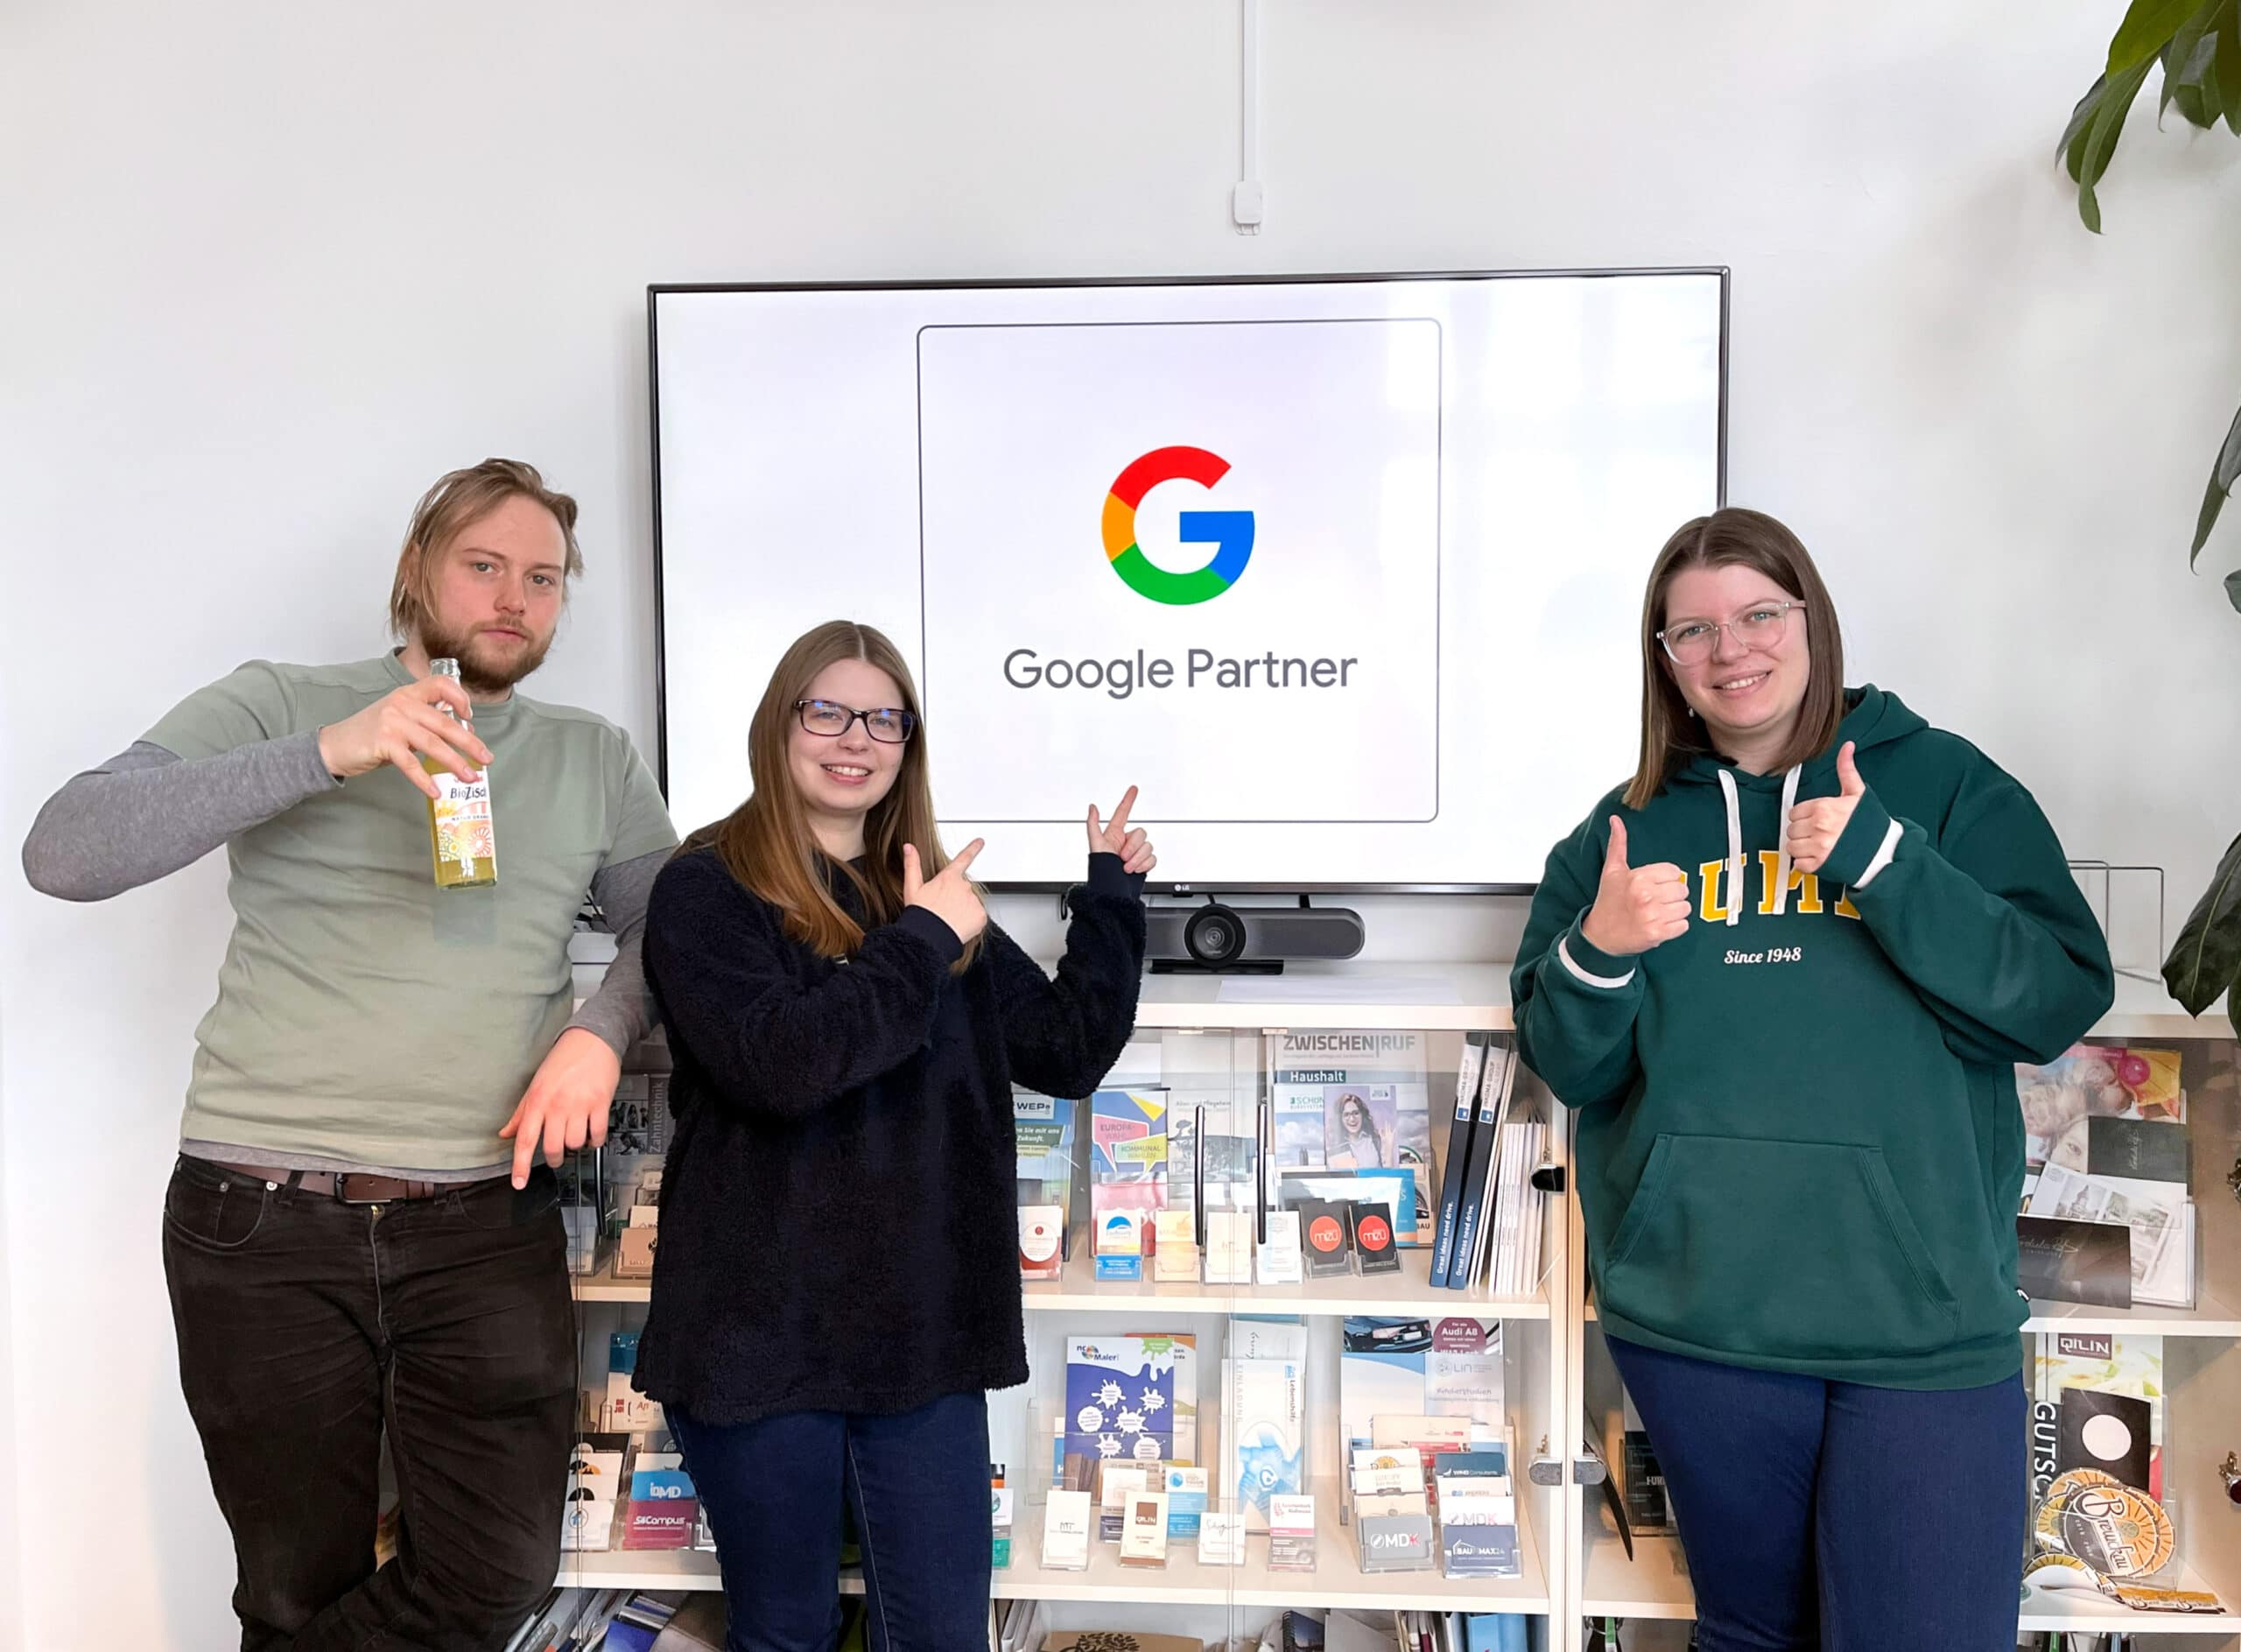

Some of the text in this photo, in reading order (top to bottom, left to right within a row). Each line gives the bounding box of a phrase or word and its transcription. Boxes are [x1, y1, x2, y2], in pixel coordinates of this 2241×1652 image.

[1004, 649, 1358, 699] Google Partner
[1724, 946, 1802, 964] Since 1948
[1290, 1071, 1344, 1083] Haushalt
[650, 1081, 664, 1153] Zahntechnik
[1437, 1255, 1445, 1274] Great
[1456, 1258, 1465, 1276] Great
[1441, 1327, 1463, 1336] Audi
[2060, 1337, 2110, 1354] QILIN
[2034, 1401, 2056, 1501] GUTSC
